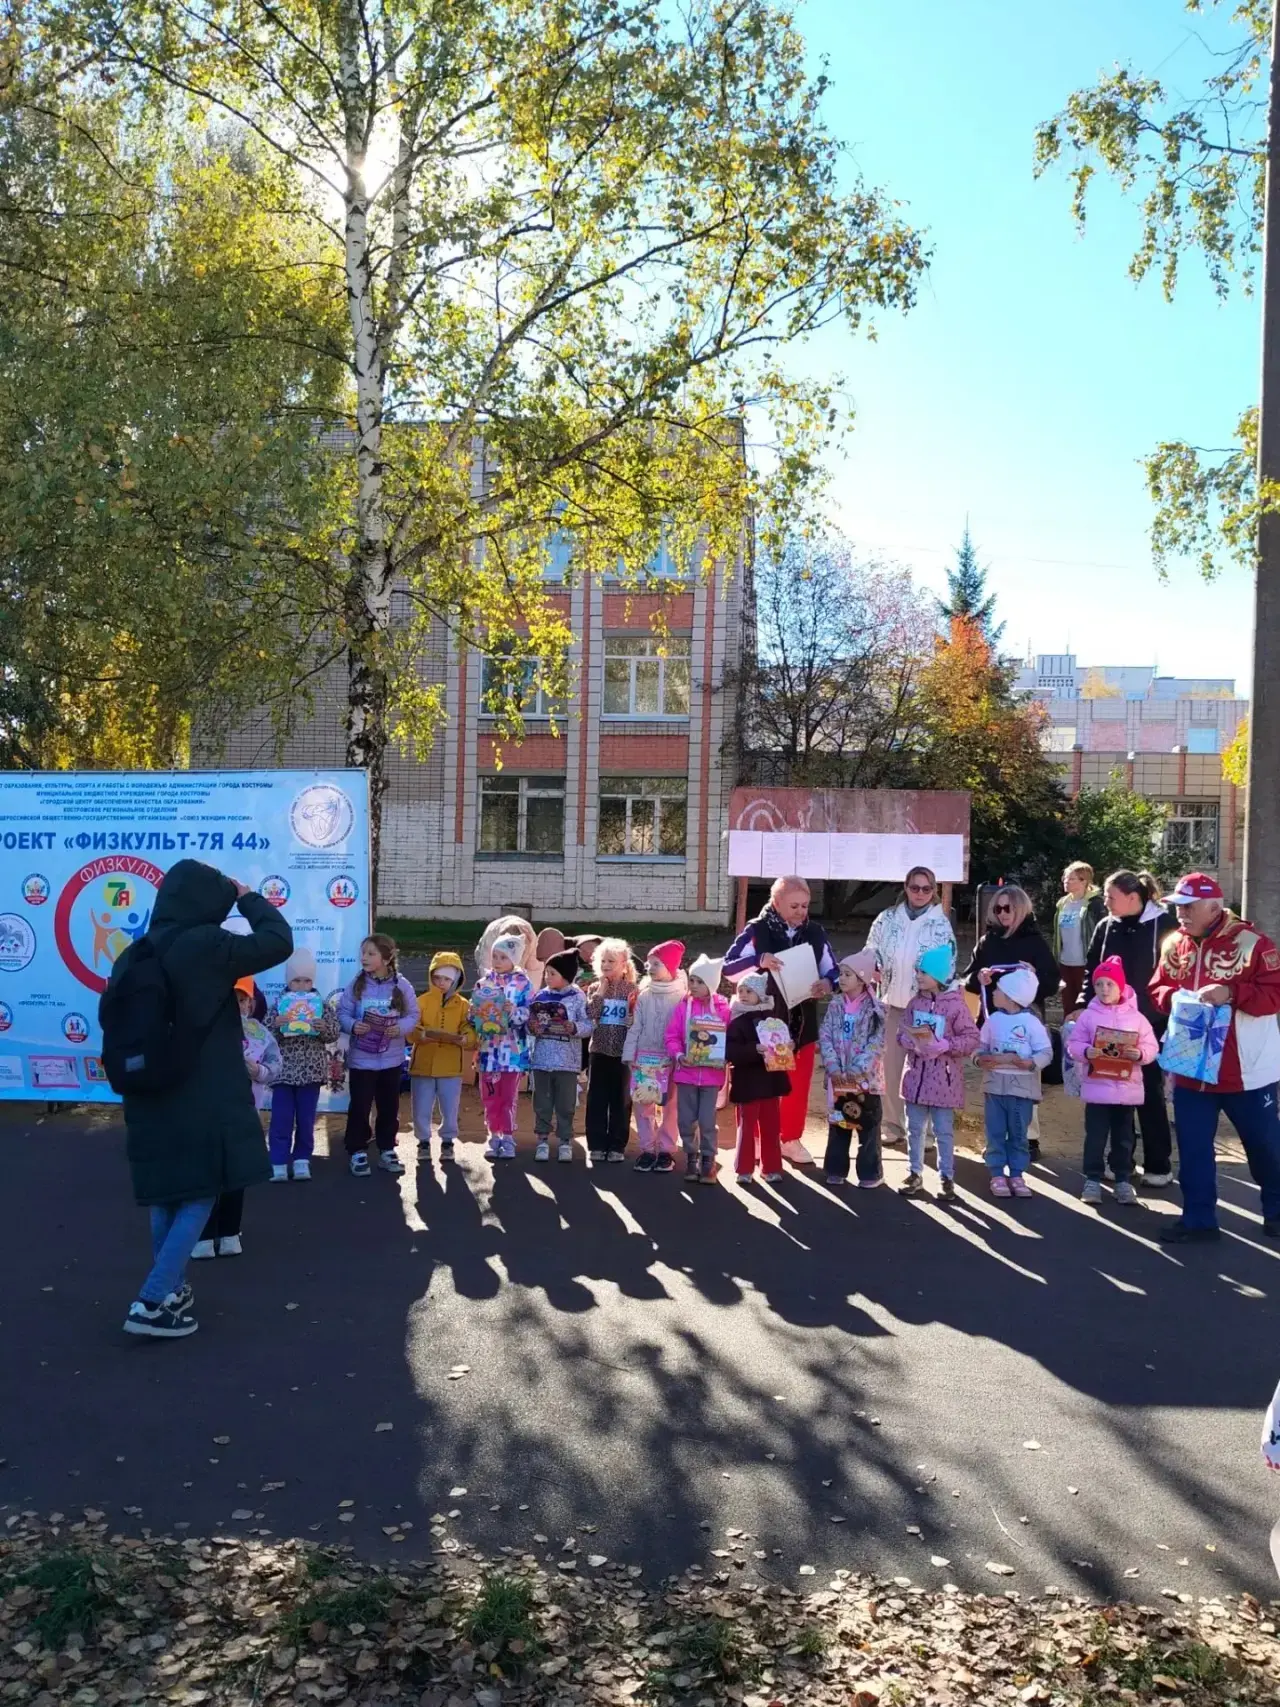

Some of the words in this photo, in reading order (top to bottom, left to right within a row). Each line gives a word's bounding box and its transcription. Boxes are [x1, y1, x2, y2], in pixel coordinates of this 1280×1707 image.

[64, 832, 224, 850] «ФИЗКУЛЬТ-7Я
[232, 832, 270, 850] 44»
[80, 857, 164, 885] ФИЗКУЛЬТ
[602, 1005, 626, 1018] 249
